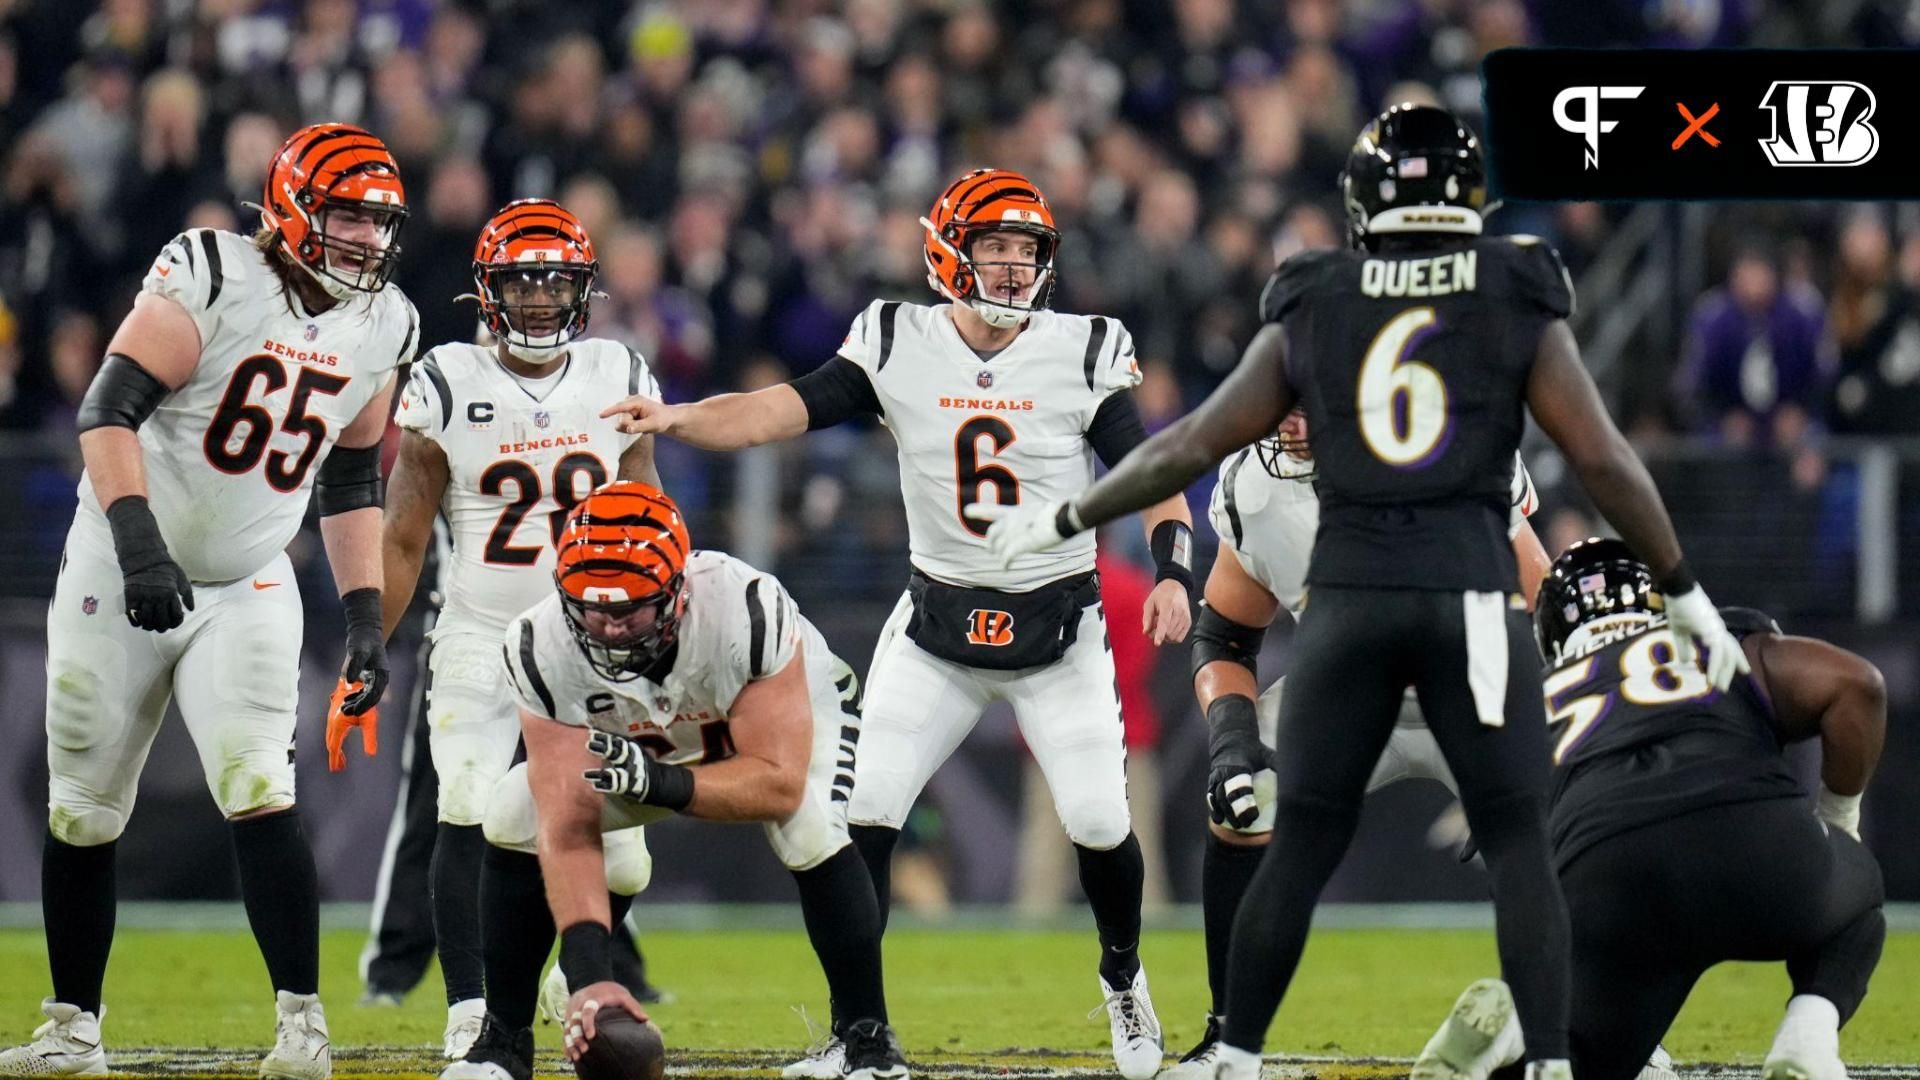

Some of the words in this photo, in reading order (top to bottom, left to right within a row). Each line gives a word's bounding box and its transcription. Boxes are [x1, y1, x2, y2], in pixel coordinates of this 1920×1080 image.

[1445, 174, 1459, 200] 6
[1361, 250, 1477, 298] QUEEN
[263, 339, 339, 367] BENGALS
[1357, 305, 1451, 467] 6
[467, 402, 494, 423] C
[939, 398, 1034, 411] BENGALS
[203, 354, 352, 493] 65
[499, 433, 589, 454] BENGALS
[954, 414, 1021, 539] 6
[585, 692, 615, 714] C
[1543, 628, 1713, 767] 58
